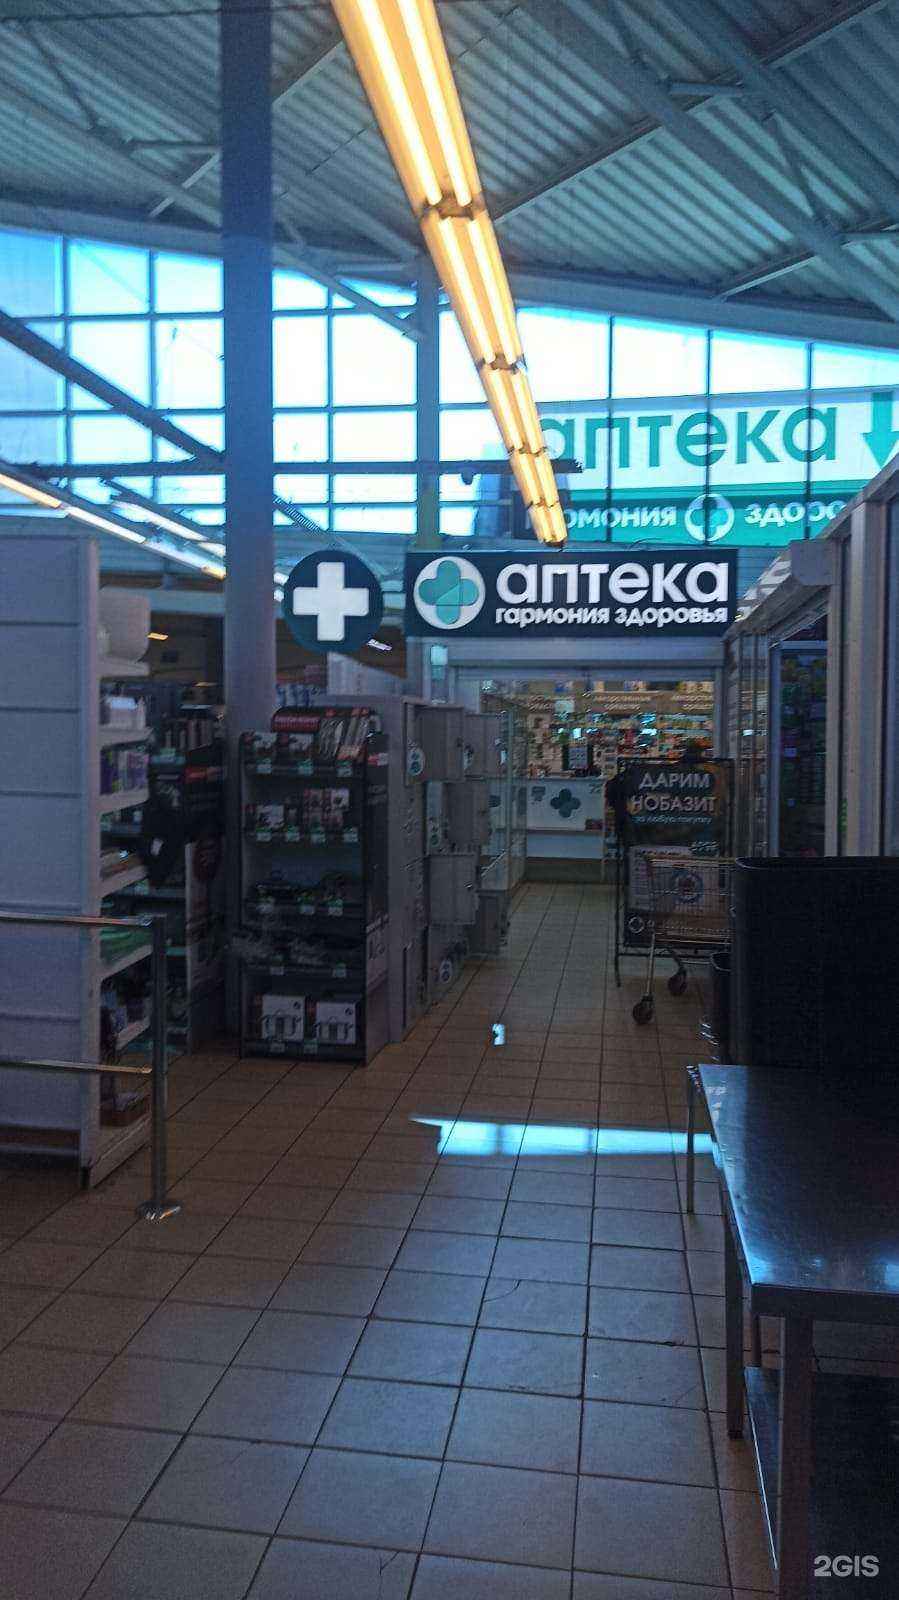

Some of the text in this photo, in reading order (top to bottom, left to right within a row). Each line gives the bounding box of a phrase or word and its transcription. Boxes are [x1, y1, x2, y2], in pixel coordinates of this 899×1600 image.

[540, 406, 836, 469] аптека
[496, 562, 729, 604] аптека
[495, 606, 729, 628] гармония здоровья
[639, 772, 711, 789] ДАРИМ
[631, 796, 717, 812] НОБАЗИТ
